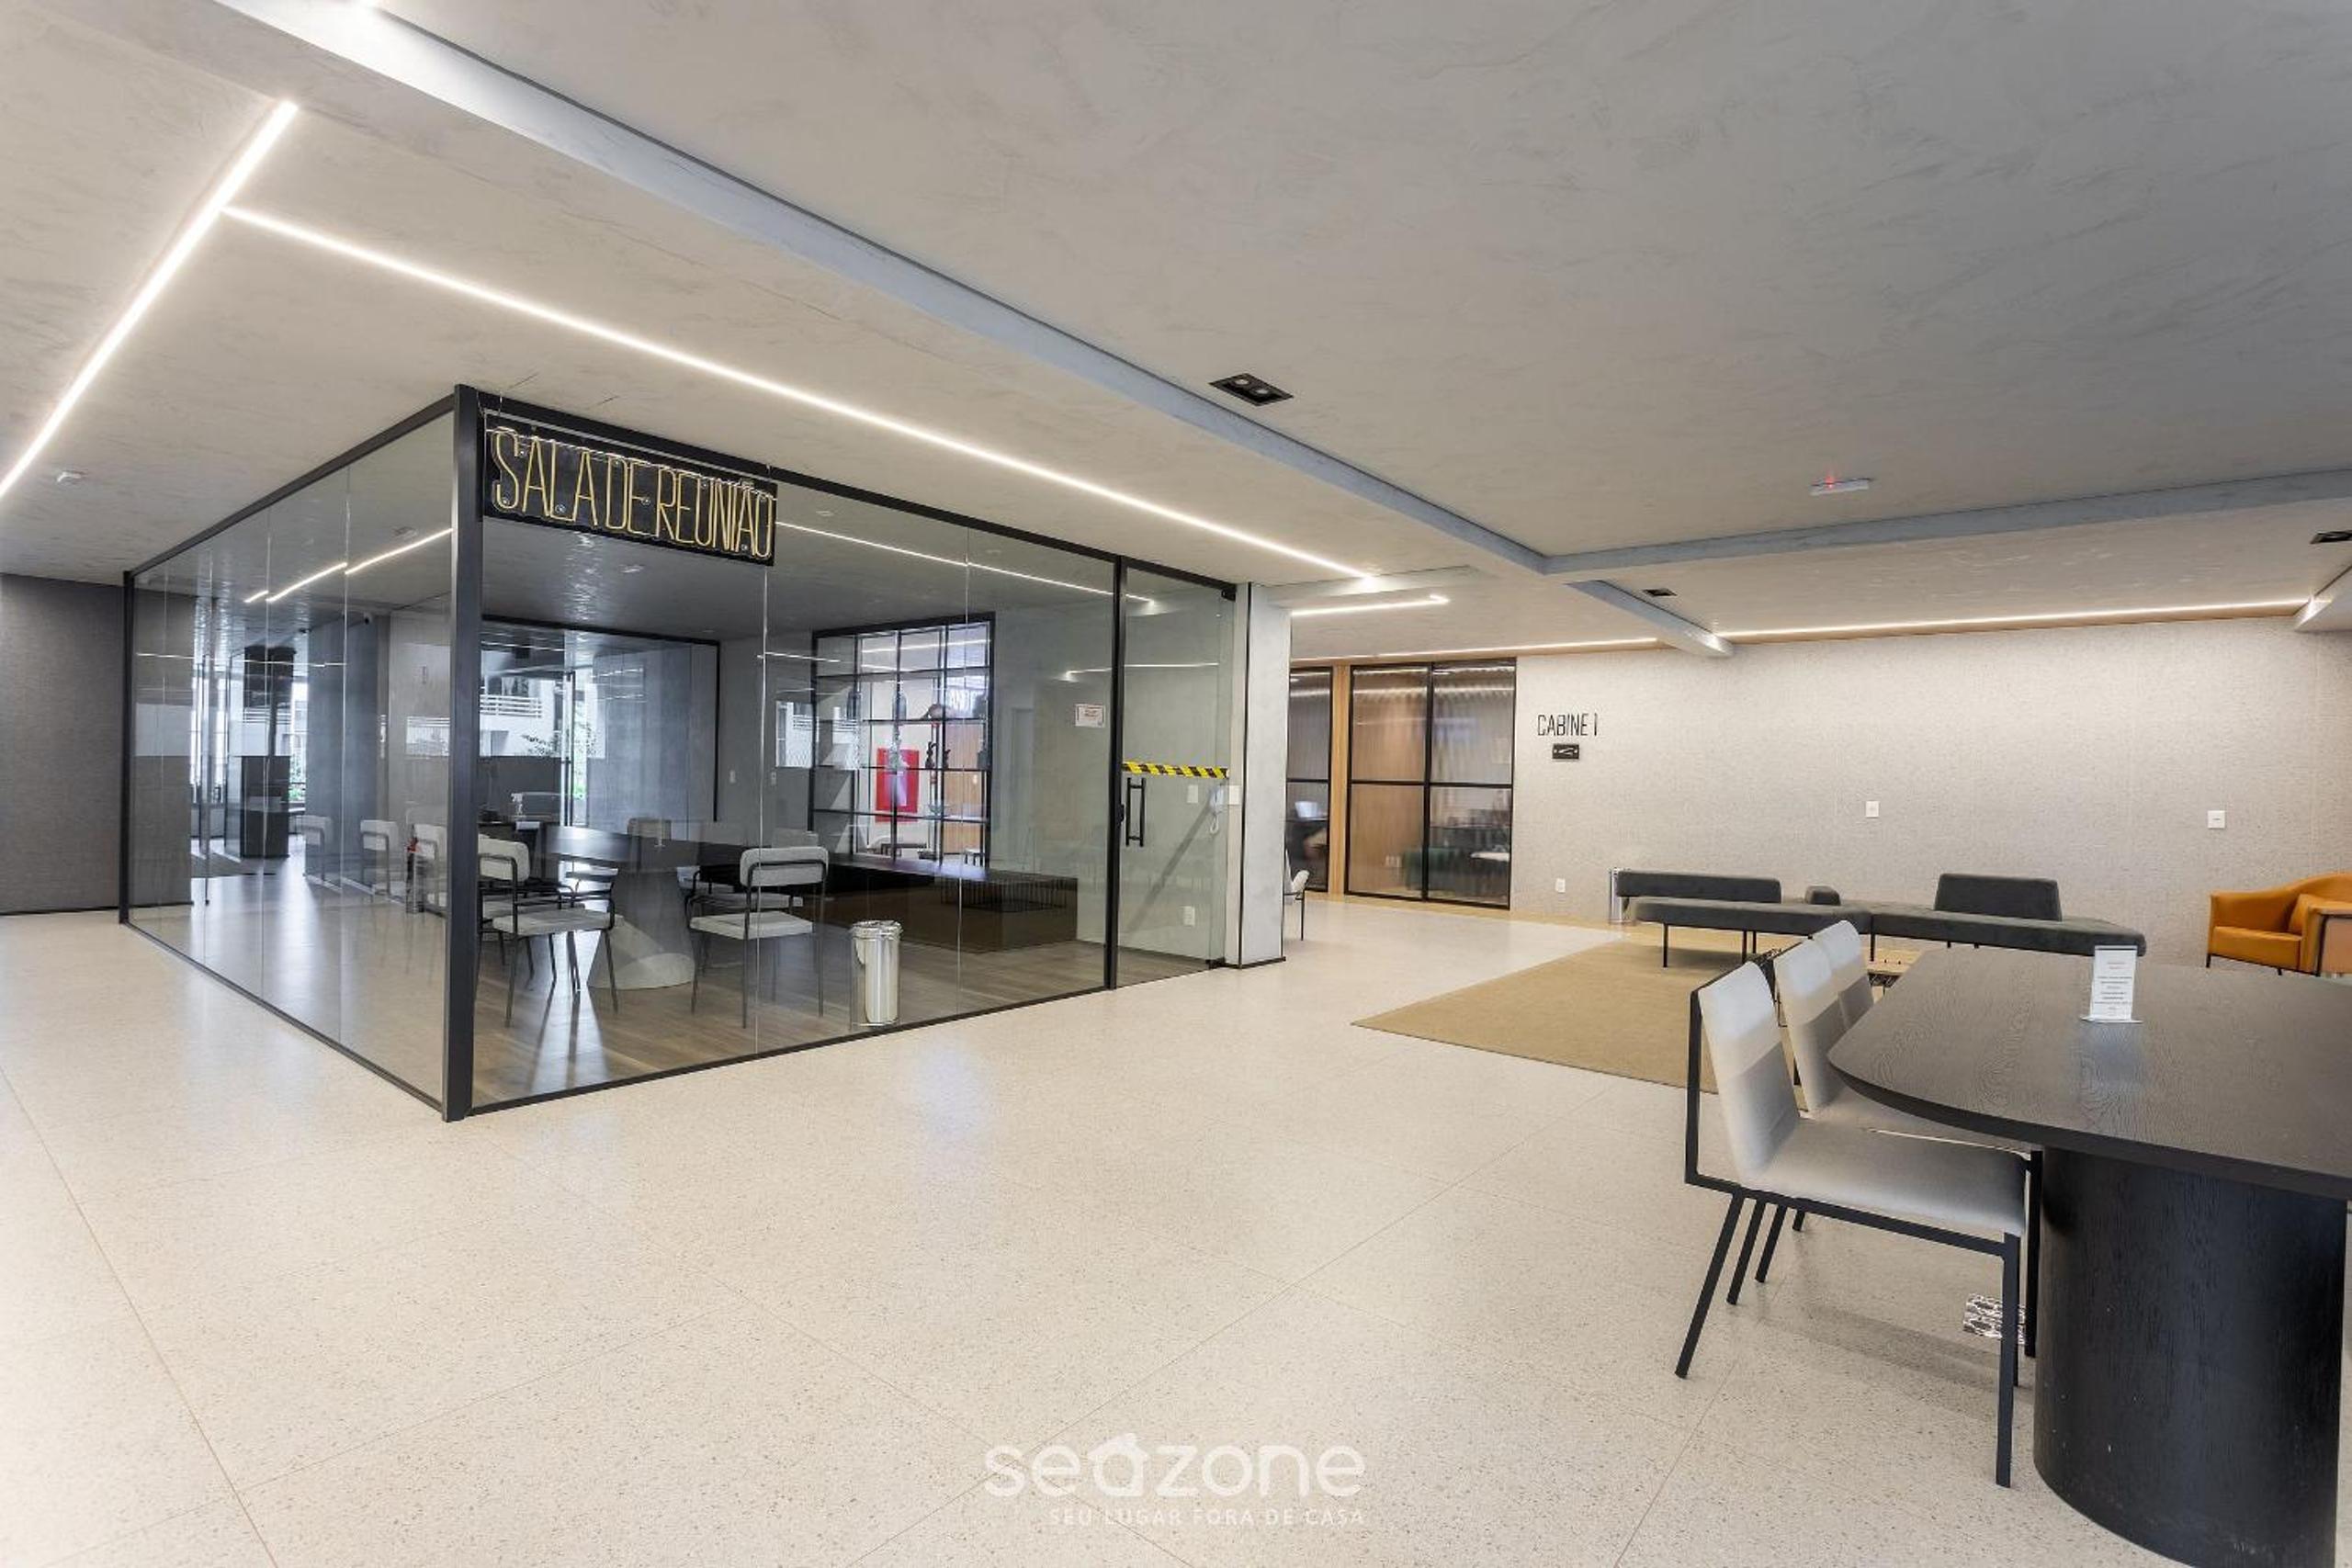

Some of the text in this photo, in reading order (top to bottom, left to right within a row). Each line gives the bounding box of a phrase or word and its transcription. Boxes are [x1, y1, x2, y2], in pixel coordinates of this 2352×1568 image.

[492, 426, 598, 526] SALA
[605, 453, 656, 536] DE
[1537, 713, 1589, 737] CABINE
